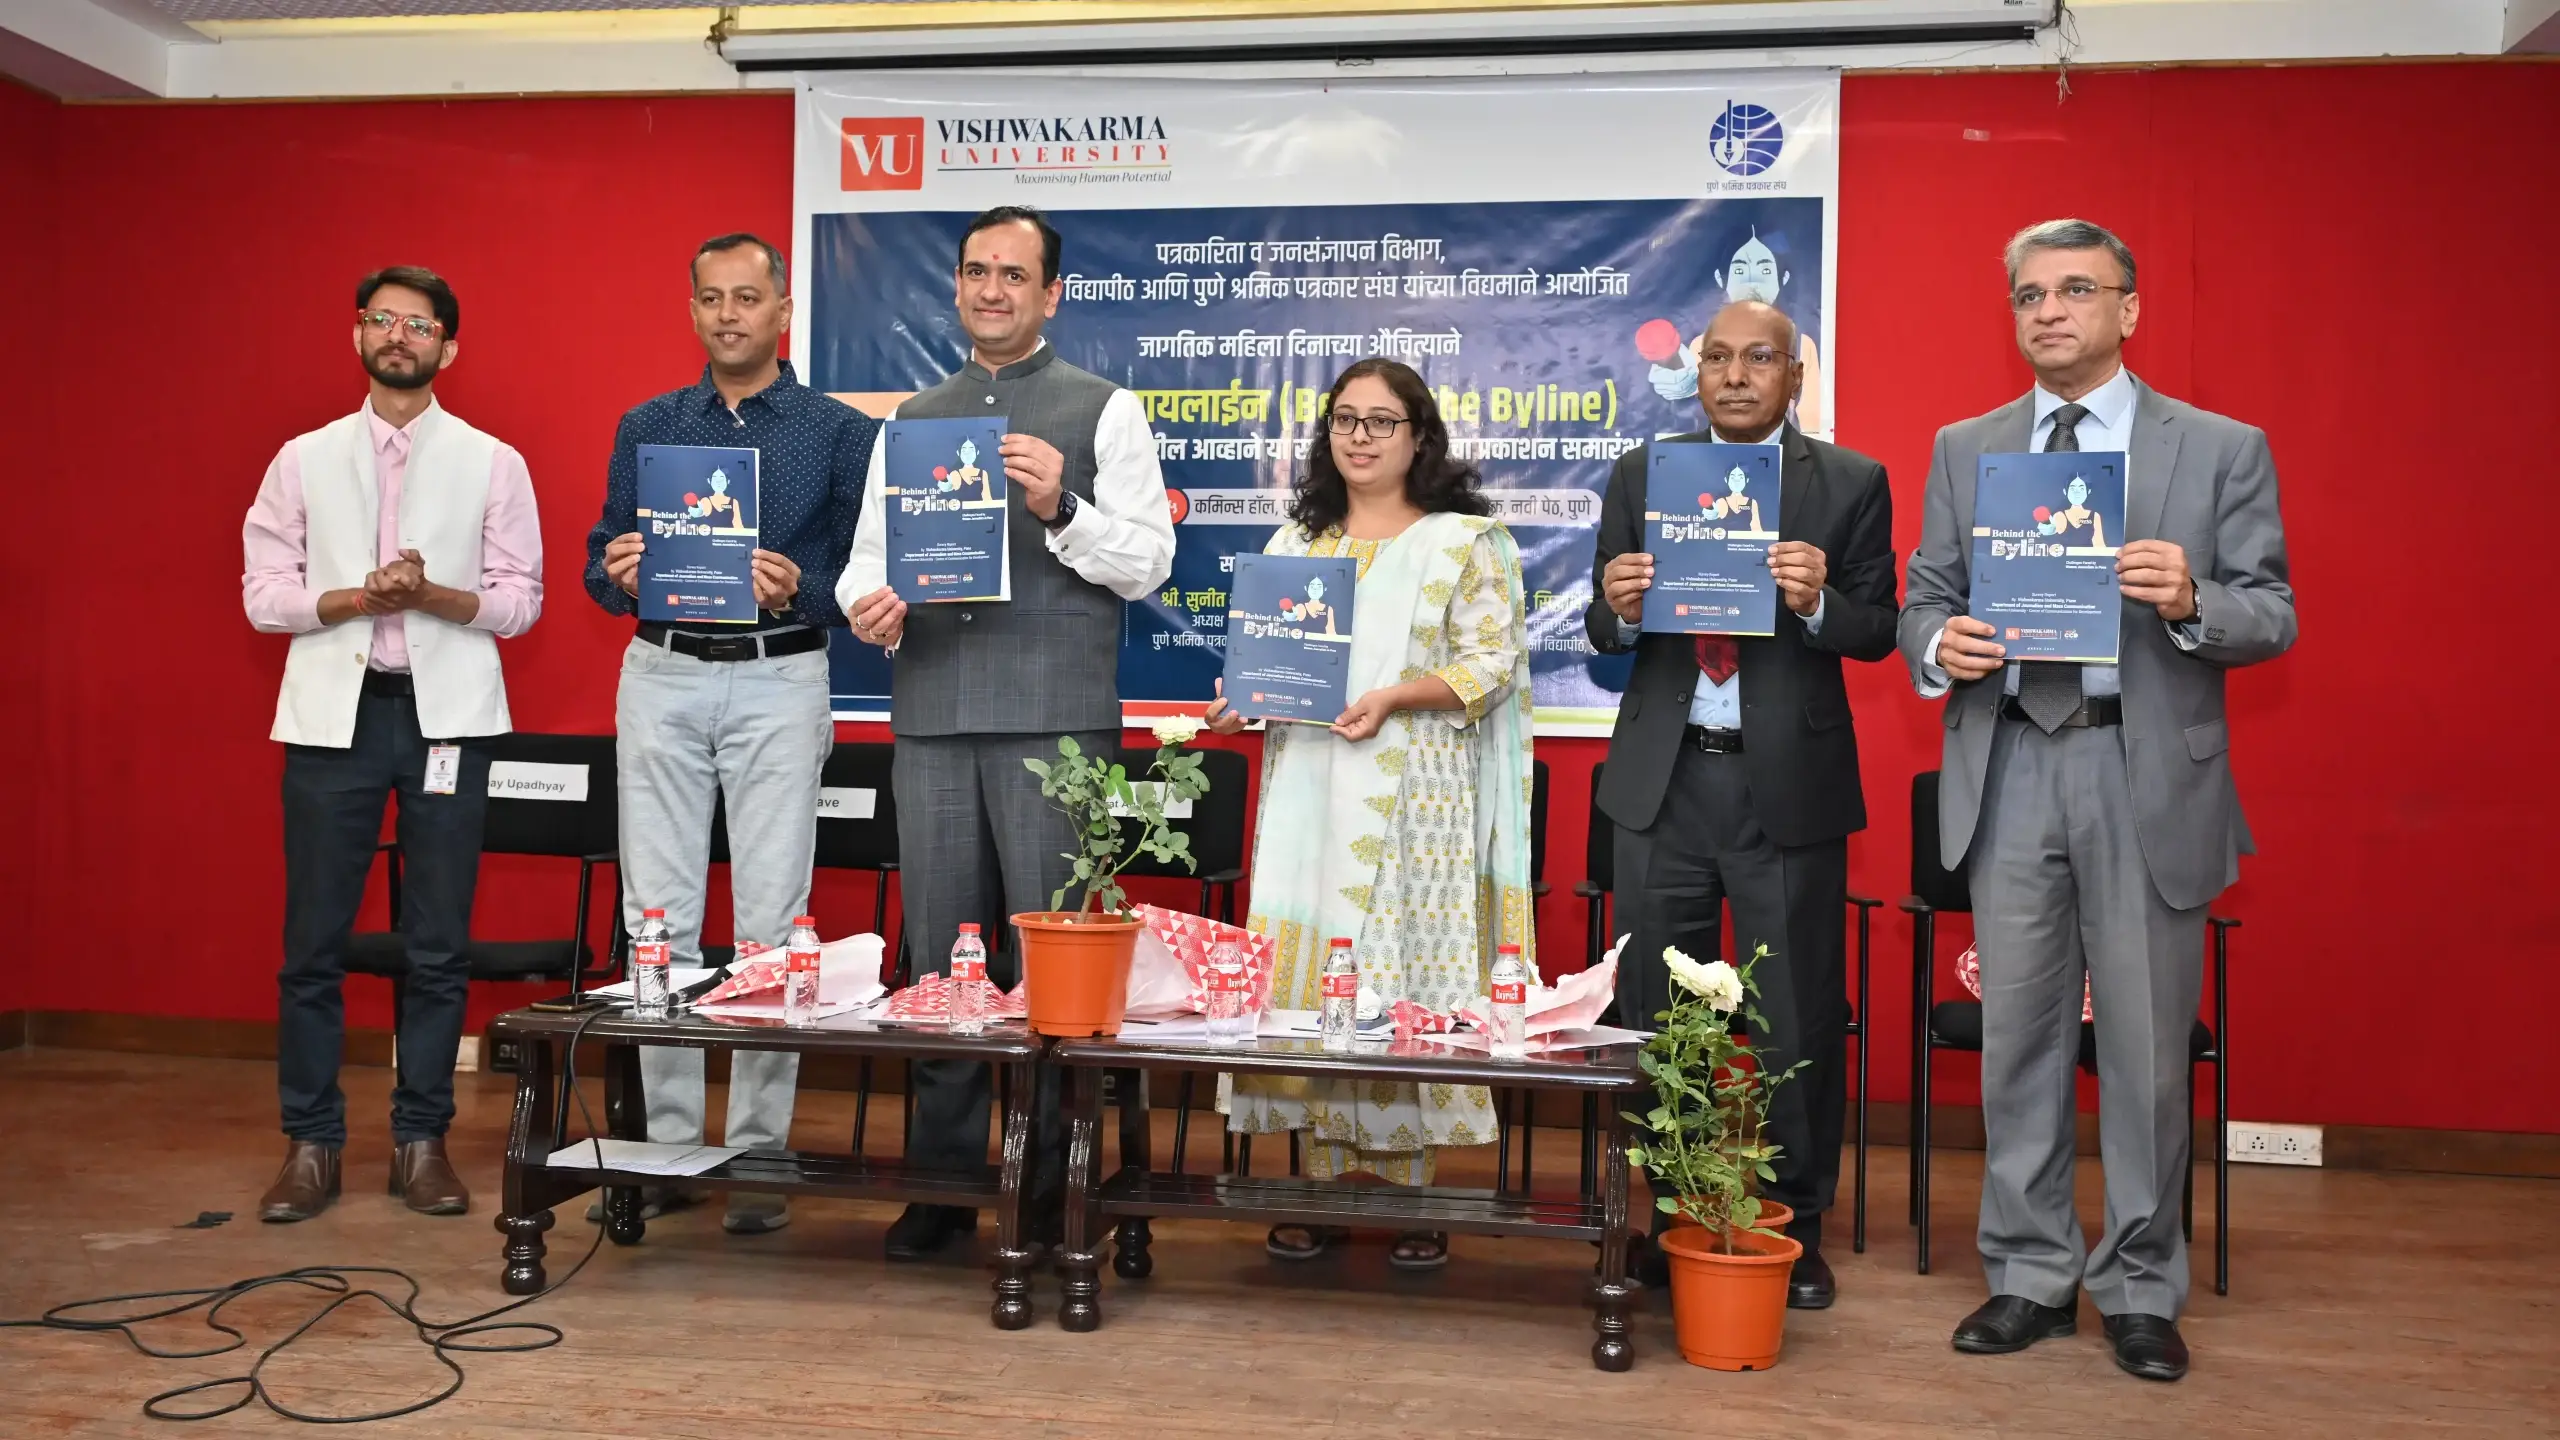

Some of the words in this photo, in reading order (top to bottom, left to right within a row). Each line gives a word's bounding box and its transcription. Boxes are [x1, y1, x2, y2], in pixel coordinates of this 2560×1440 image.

[937, 115, 1168, 143] VISHWAKARMA
[848, 134, 916, 176] VU
[941, 144, 1171, 165] UNIVERSITY
[1014, 173, 1077, 186] Maximising
[1079, 172, 1120, 184] Human
[1122, 170, 1172, 183] Potential
[1156, 236, 1247, 265] पत्रकारिता
[1249, 242, 1264, 262] व
[1268, 236, 1377, 263] जनसंज्ञापन
[1381, 233, 1445, 264] विभाग,
[1064, 273, 1136, 301] विद्यापीठ
[1141, 272, 1191, 301] आणि
[1193, 272, 1226, 306] पुणे
[1231, 271, 1291, 299] श्रमिक
[1294, 276, 1360, 299] पत्रकार
[1363, 271, 1398, 298] संघ
[1402, 271, 1456, 298] यांच्या
[1460, 268, 1540, 296] विद्यमाने
[1544, 266, 1630, 296] आयोजित
[1137, 330, 1215, 358] जागतिक
[1218, 329, 1283, 357] महिला
[1287, 328, 1363, 357] दिनाच्या
[1368, 327, 1462, 357] औचित्याने
[1491, 379, 1617, 429] Byline)
[1192, 432, 1263, 460] आव्हाने
[1264, 438, 1293, 460] या
[1476, 437, 1558, 460] प्रकाशन
[901, 487, 927, 496] Behind
[929, 487, 941, 495] the
[652, 511, 678, 519] Behind
[679, 511, 692, 520] the
[901, 495, 961, 515] Byline
[1195, 494, 1245, 515] कमिन्स
[1248, 494, 1279, 517] हॉल,
[1511, 496, 1539, 516] नवी
[1542, 495, 1564, 518] पेठ,
[1568, 495, 1593, 520] पुणे
[652, 519, 711, 538] Byline
[1662, 514, 1690, 522] Behind
[1693, 514, 1706, 522] the
[1662, 522, 1727, 543] Byline
[1992, 529, 2024, 537] Behind
[2027, 529, 2041, 538] the
[1991, 538, 2064, 560] Byline
[1161, 587, 1182, 607] श्री.
[1185, 587, 1227, 613] सुनीत
[1191, 614, 1225, 628] अध्यक्ष
[1245, 612, 1272, 622] Behind
[1273, 613, 1285, 623] the
[1243, 620, 1304, 639] Byline
[1152, 631, 1170, 651] पुणे
[1172, 631, 1205, 648] श्रमिक
[1544, 635, 1588, 654] विद्यापीठ,
[507, 778, 565, 792] Upadhyay
